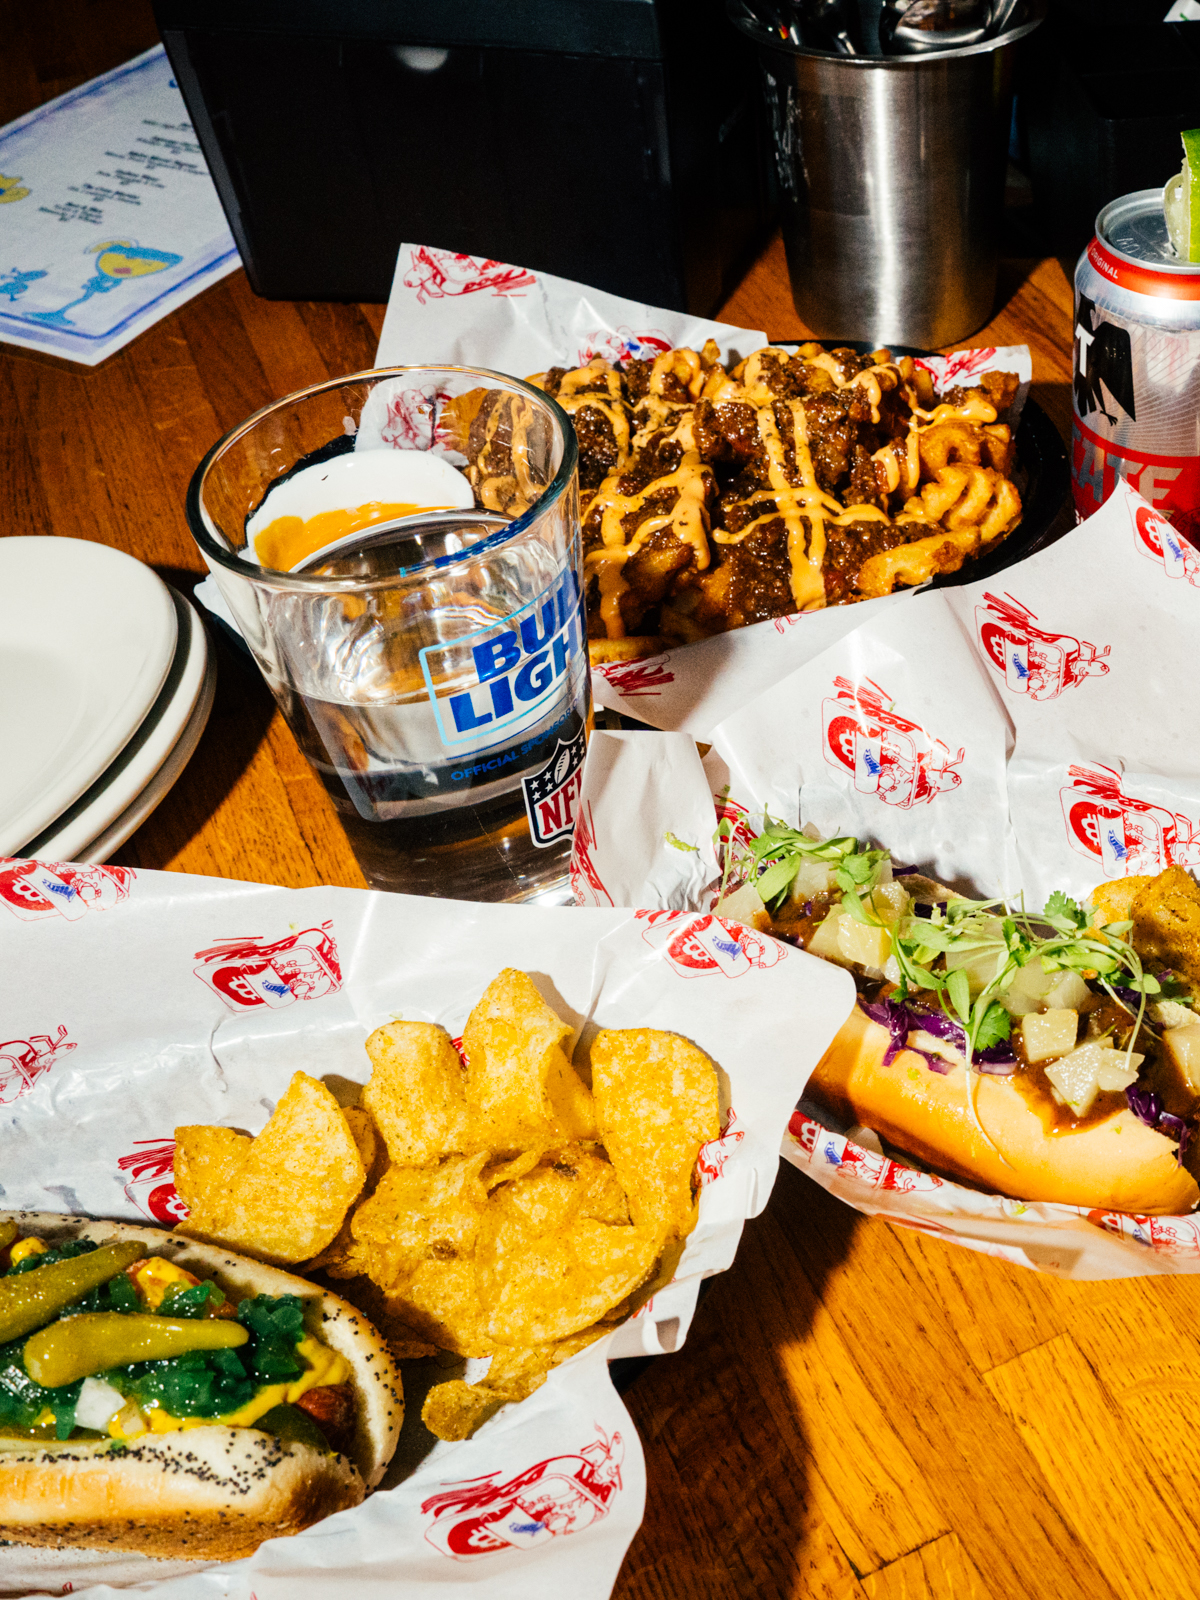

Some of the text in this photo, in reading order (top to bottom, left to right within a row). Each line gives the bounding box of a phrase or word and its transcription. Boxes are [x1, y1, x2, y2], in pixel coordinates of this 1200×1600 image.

[1090, 247, 1119, 279] ORIGINAL
[450, 750, 519, 781] OFFICIAL
[521, 706, 572, 754] SPONSOR
